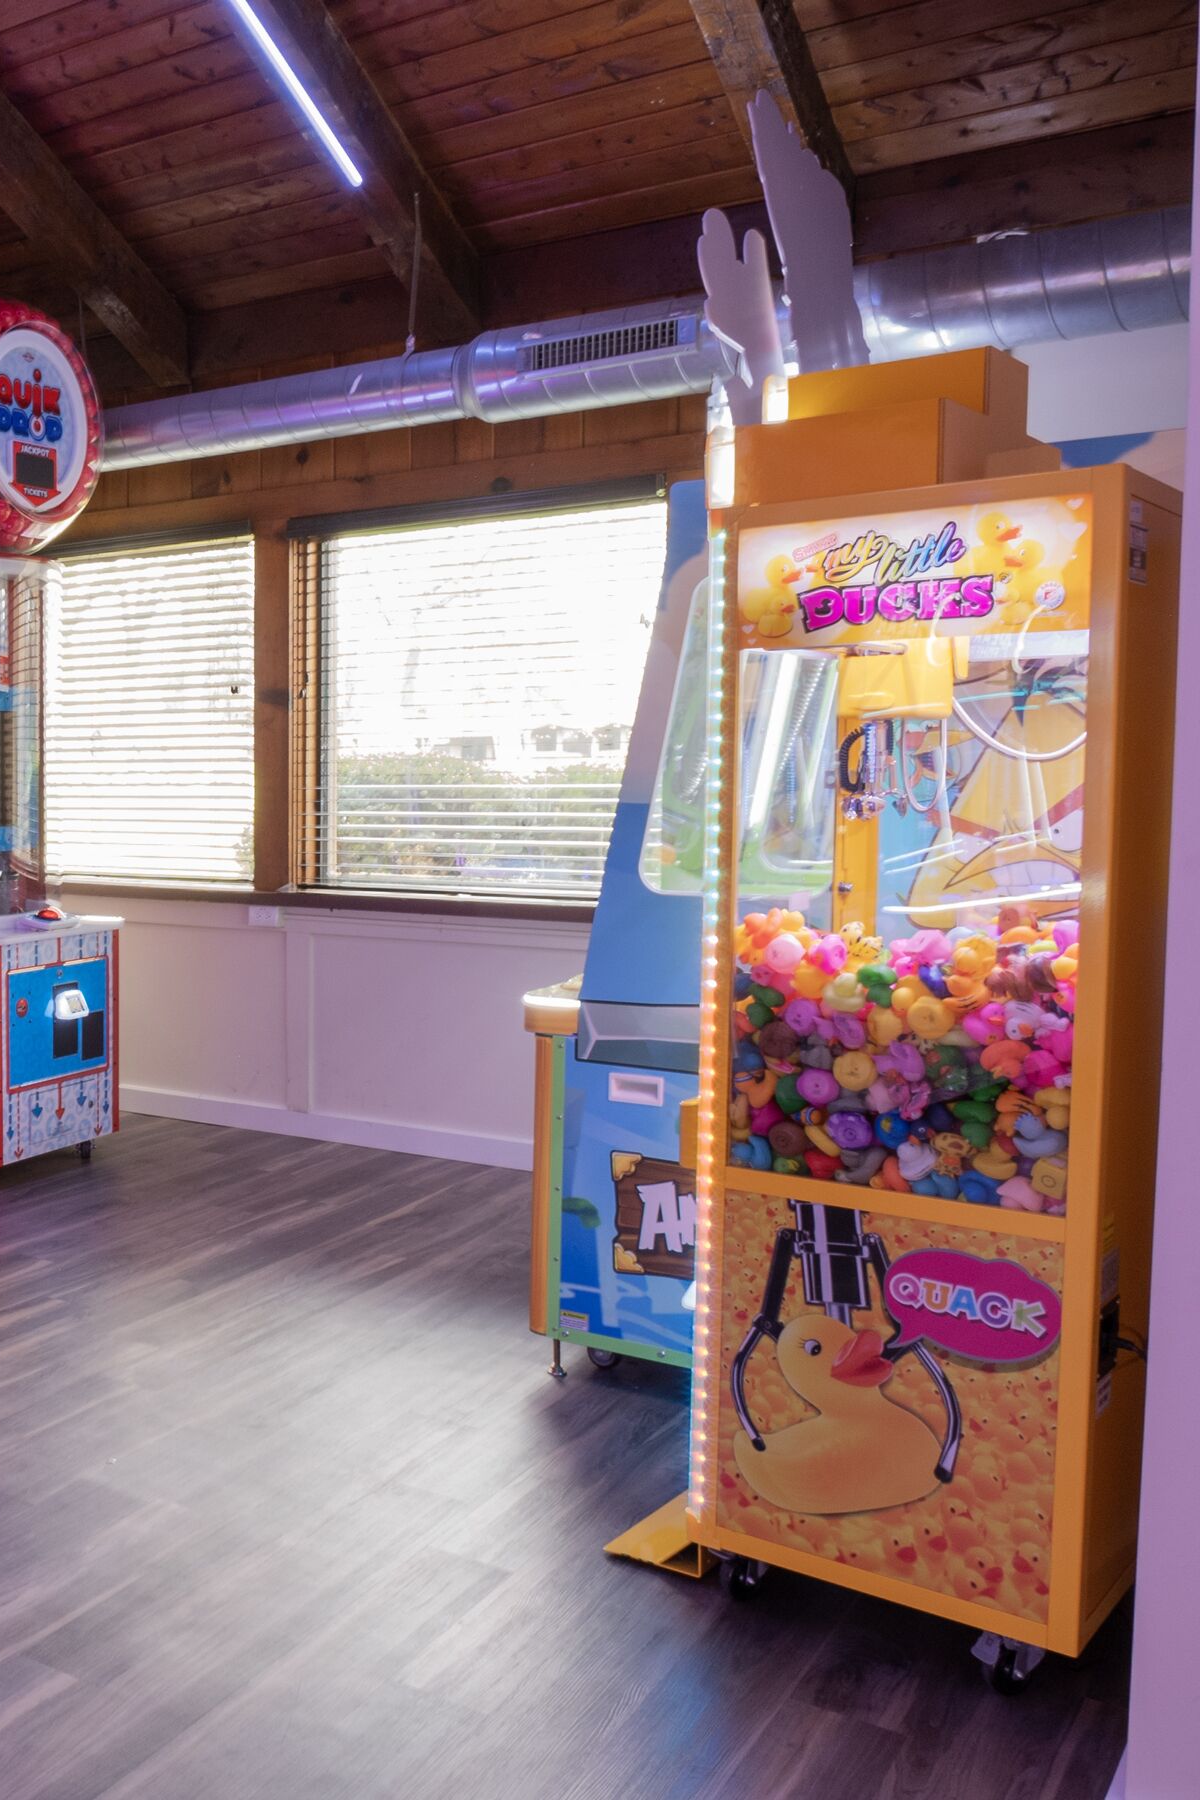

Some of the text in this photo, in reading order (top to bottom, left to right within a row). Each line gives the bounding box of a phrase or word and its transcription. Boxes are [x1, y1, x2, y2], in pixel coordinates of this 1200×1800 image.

[21, 444, 50, 458] JACKPOT
[23, 487, 48, 498] TICKETS
[874, 521, 967, 585] little
[798, 574, 995, 633] DUCKS
[889, 1272, 1047, 1338] QUACK
